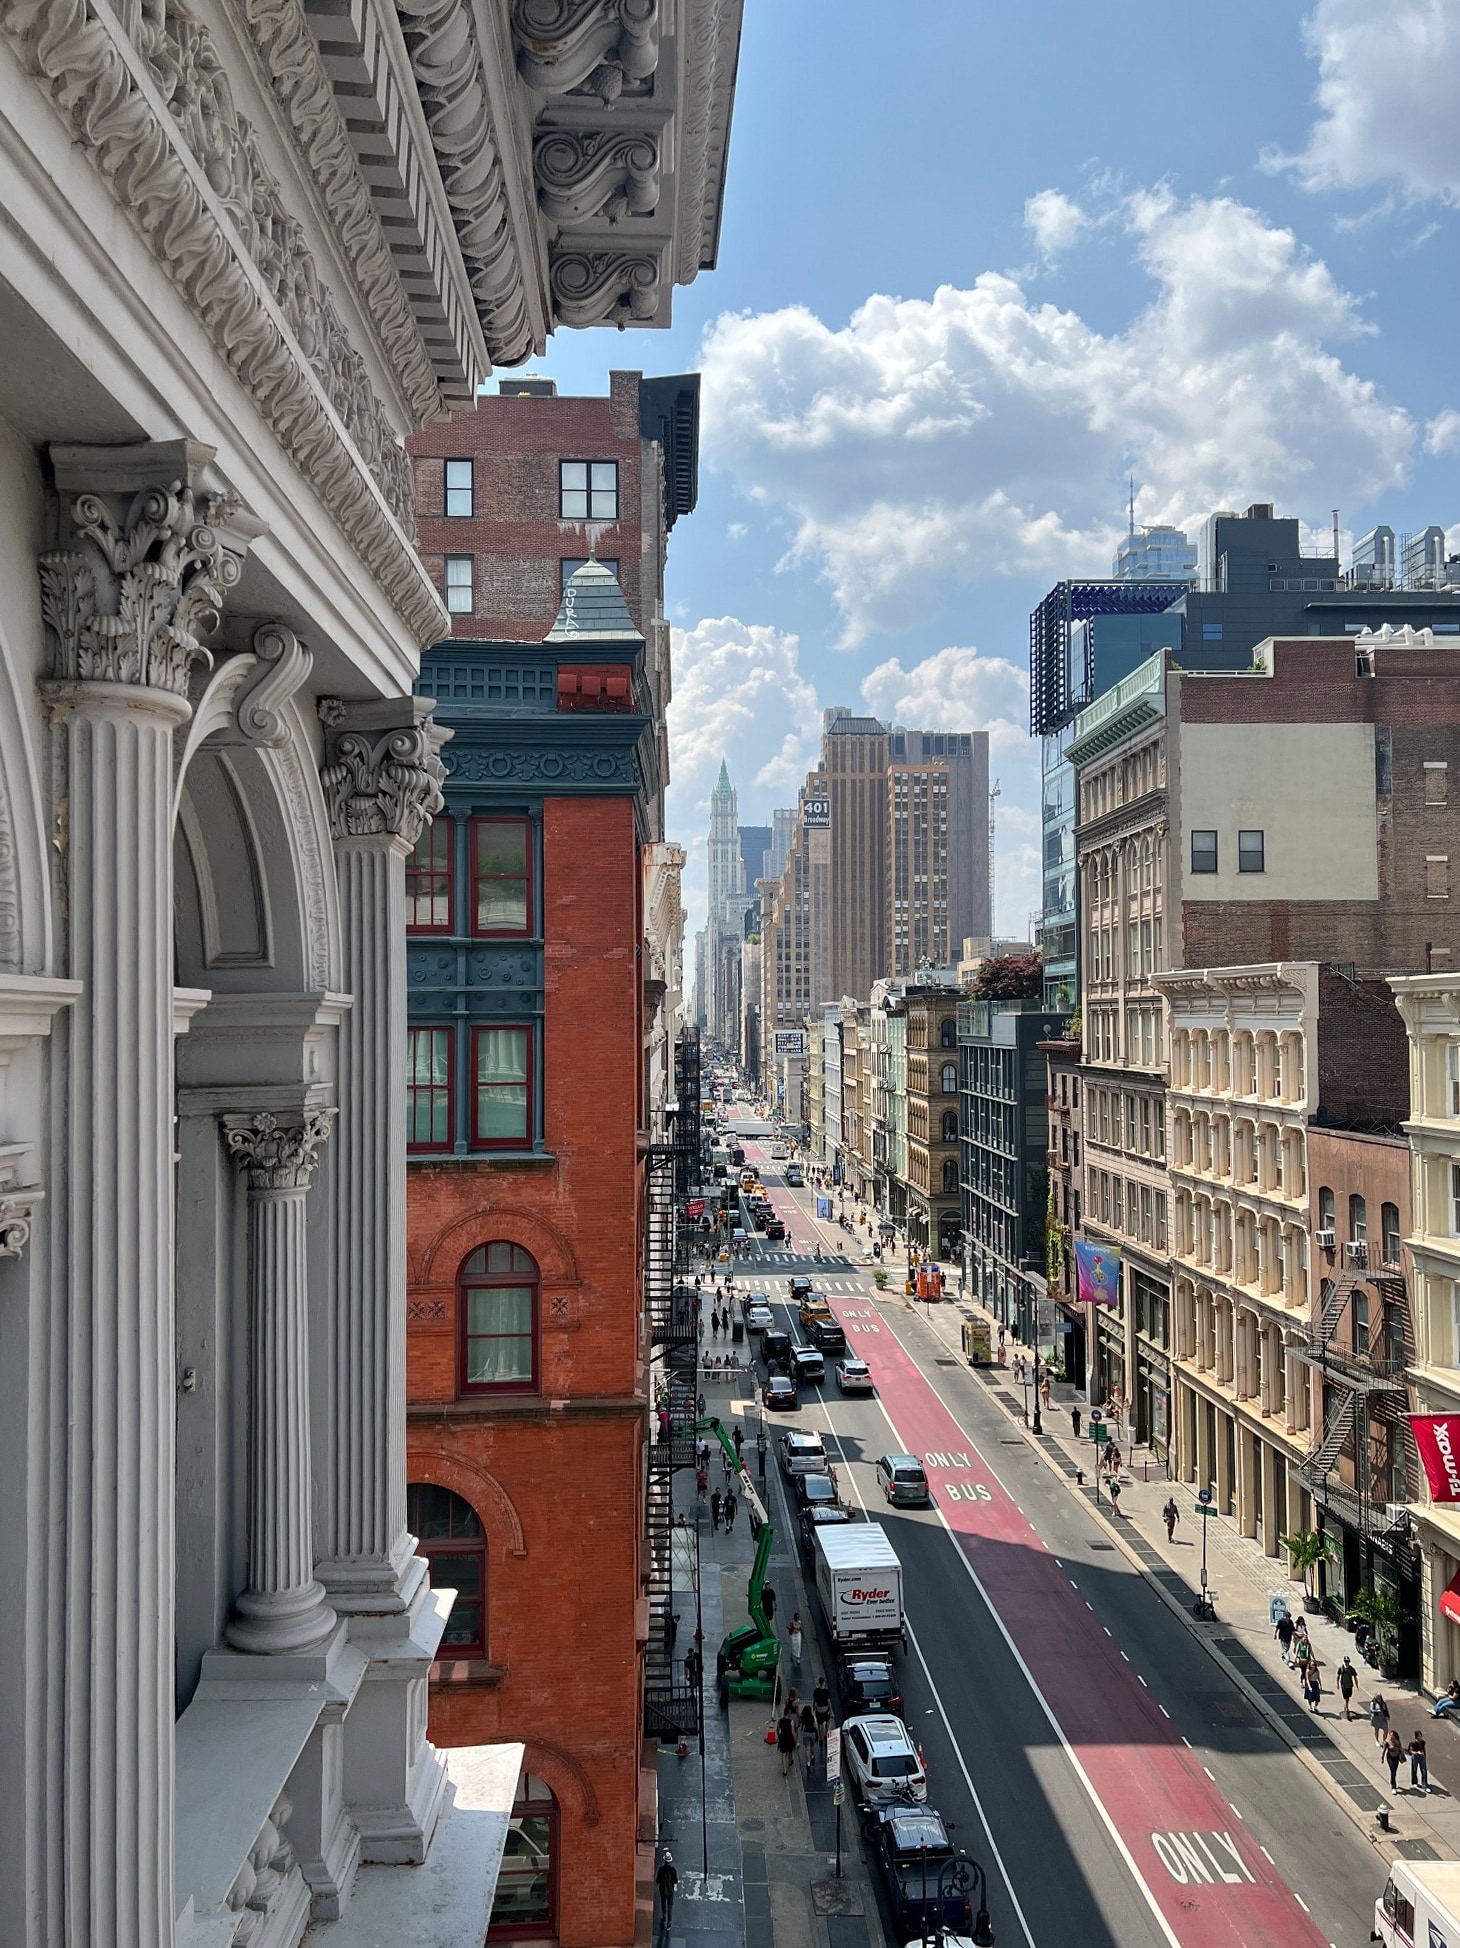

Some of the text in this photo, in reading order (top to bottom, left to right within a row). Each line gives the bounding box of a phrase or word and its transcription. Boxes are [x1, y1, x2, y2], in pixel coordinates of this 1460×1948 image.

[804, 802, 828, 813] 401
[842, 1310, 871, 1318] ONLY
[852, 1324, 880, 1333] BUS
[925, 1453, 972, 1467] ONLY
[944, 1484, 992, 1501] BUS
[852, 1588, 890, 1601] Ryder
[1151, 1831, 1257, 1884] ONLY
